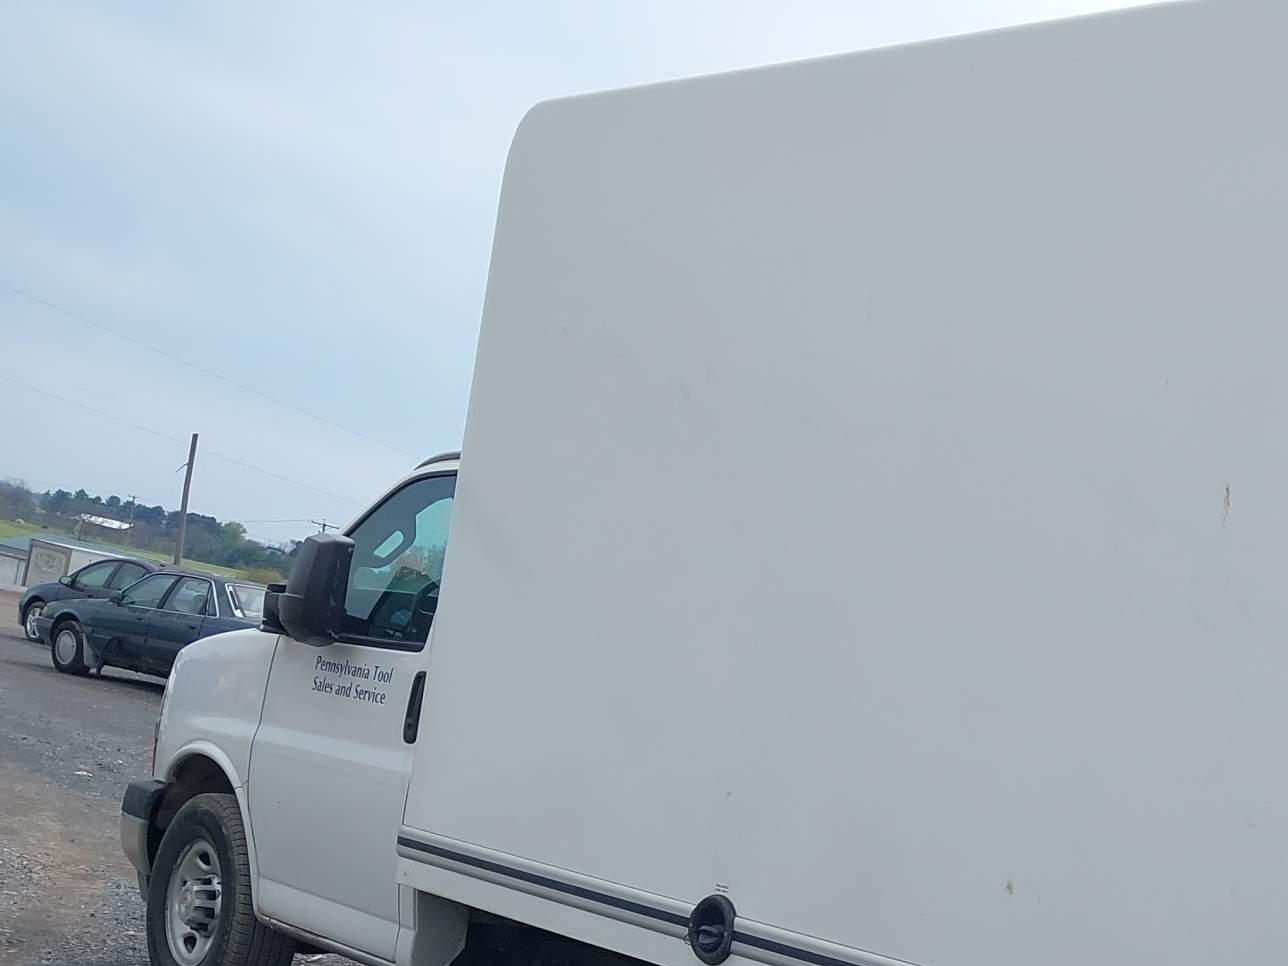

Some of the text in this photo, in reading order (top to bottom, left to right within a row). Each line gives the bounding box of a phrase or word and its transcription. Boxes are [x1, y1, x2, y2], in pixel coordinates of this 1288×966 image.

[314, 655, 394, 684] Pennsylvania Tool
[311, 675, 386, 705] Sales and Service
